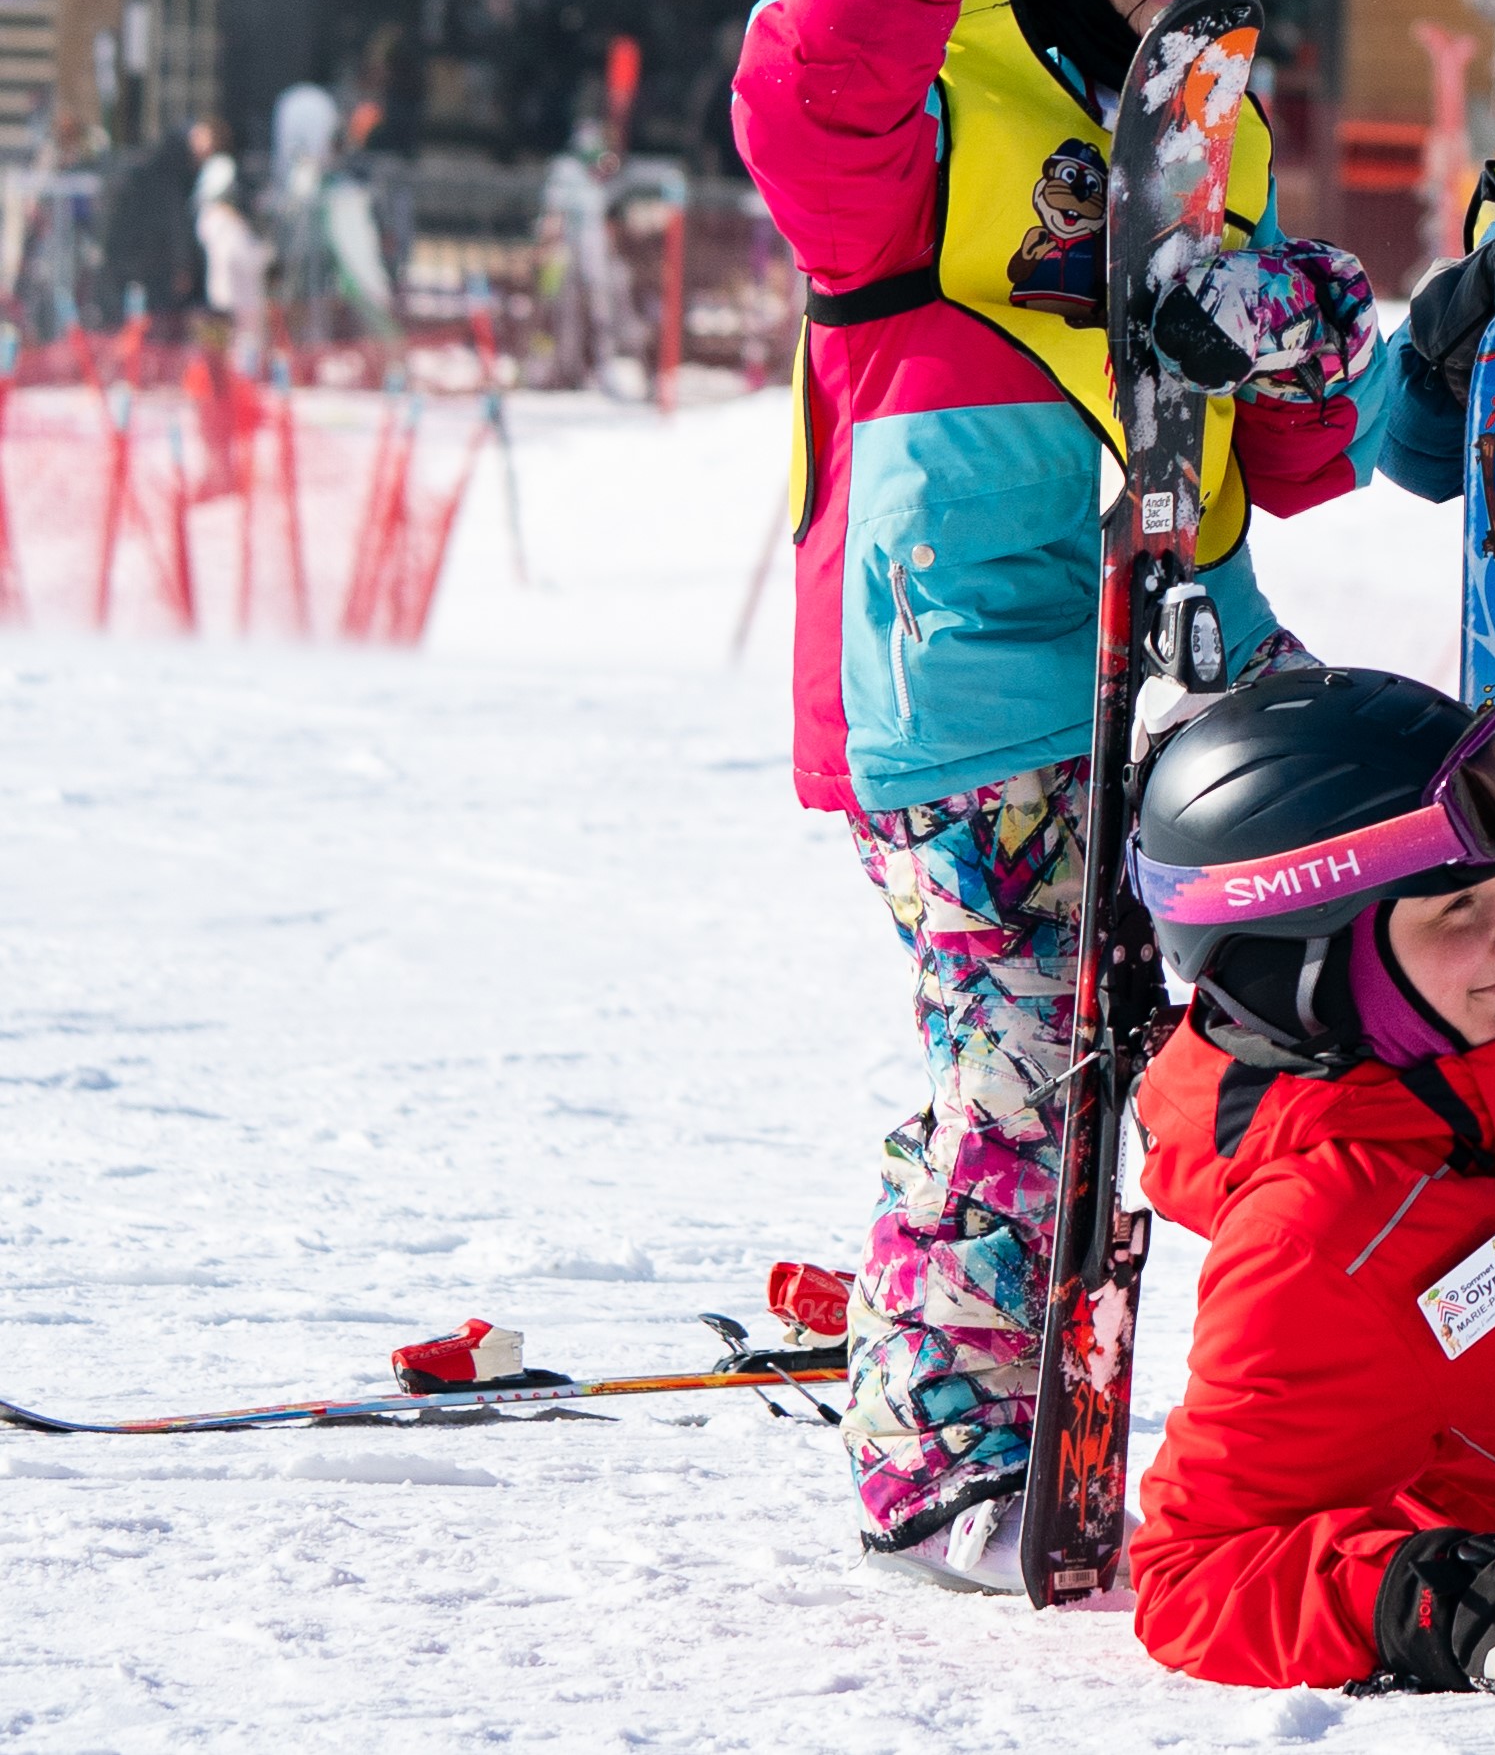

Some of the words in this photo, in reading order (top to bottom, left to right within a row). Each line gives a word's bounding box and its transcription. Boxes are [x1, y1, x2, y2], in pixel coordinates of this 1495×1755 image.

[1144, 495, 1171, 509] André
[1144, 518, 1171, 531] Sport
[1224, 848, 1361, 907] SMITH
[1460, 1264, 1495, 1294] Sommet
